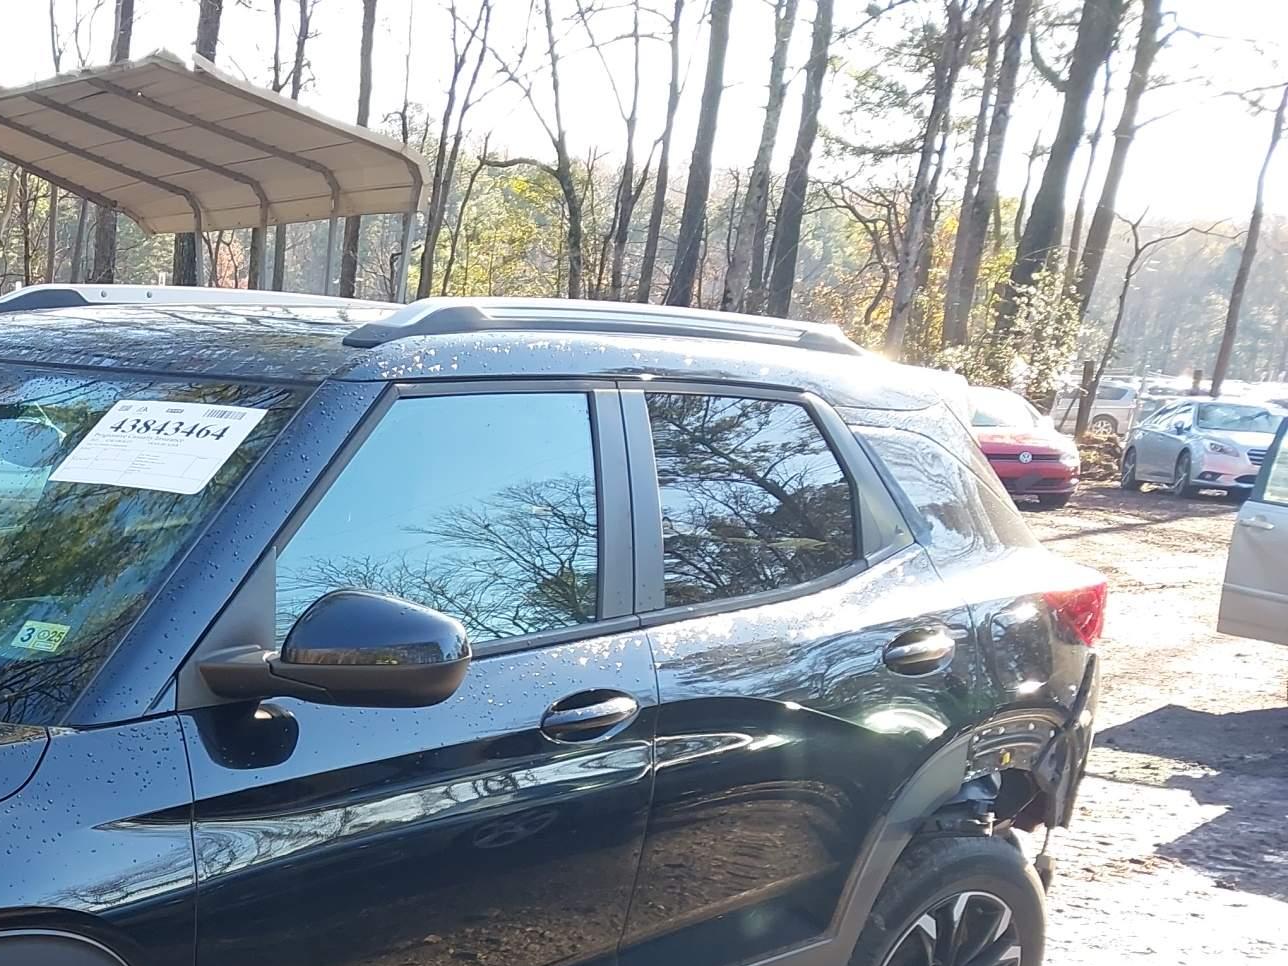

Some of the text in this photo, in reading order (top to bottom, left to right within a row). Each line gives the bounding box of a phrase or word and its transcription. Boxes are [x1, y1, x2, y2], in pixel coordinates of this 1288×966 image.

[110, 417, 231, 441] 43843464
[20, 627, 65, 643] 3 25
